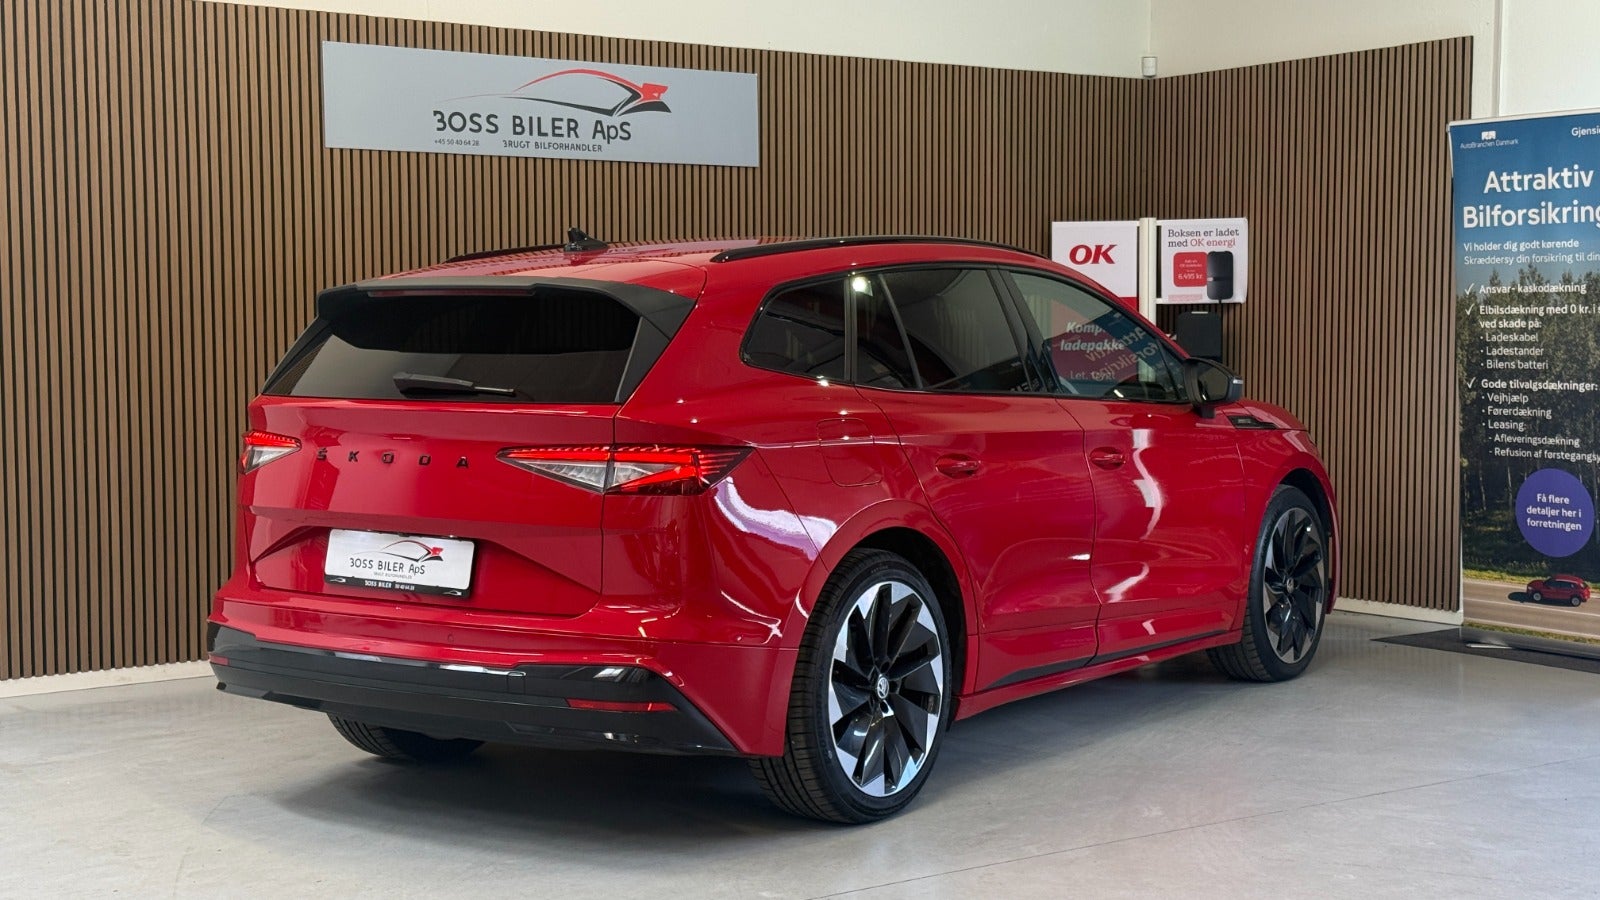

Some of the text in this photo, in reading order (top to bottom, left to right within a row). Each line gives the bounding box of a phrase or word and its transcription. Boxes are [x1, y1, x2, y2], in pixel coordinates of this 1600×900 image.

[512, 115, 579, 138] BILER
[592, 119, 632, 144] ApS
[534, 141, 602, 152] BILFORHANDLER
[1460, 138, 1519, 149] AutoBranchen Danmark
[1483, 164, 1594, 194] Attraktiv
[1167, 228, 1202, 237] Boksen
[1215, 228, 1240, 237] ladet
[1168, 238, 1236, 248] med OK energi
[1464, 238, 1580, 252] Vi holder dig godt kørende
[1068, 244, 1117, 266] OK
[1464, 254, 1514, 266] Skræddersy
[1516, 254, 1530, 264] din
[1532, 252, 1573, 265] forsikring
[1575, 252, 1585, 262] til
[1479, 283, 1587, 294] Ansvar- kaskodækning
[1479, 304, 1545, 317] Elbilsdækning
[1546, 304, 1568, 314] med
[1570, 304, 1577, 314] 0
[1579, 304, 1591, 314] kr.
[1480, 318, 1542, 330] ved skade på:
[1485, 333, 1538, 342] Ladeskabel
[1486, 346, 1544, 356] Ladestander
[1486, 360, 1549, 370] Bilens batteri
[1481, 378, 1598, 392] Gode tilvalgsdækninger:
[1487, 393, 1529, 404] Vejhjælp
[1487, 406, 1552, 420] Førerdækning
[1494, 434, 1580, 448] Afleveringsdækning
[1494, 448, 1532, 458] Refusion
[1534, 450, 1542, 458] af
[1536, 493, 1570, 505] Få flere
[1526, 506, 1560, 518] detaljer
[1562, 508, 1577, 518] her
[1526, 518, 1582, 532] forretningen
[377, 561, 404, 573] BILER
[408, 564, 426, 576] ApS
